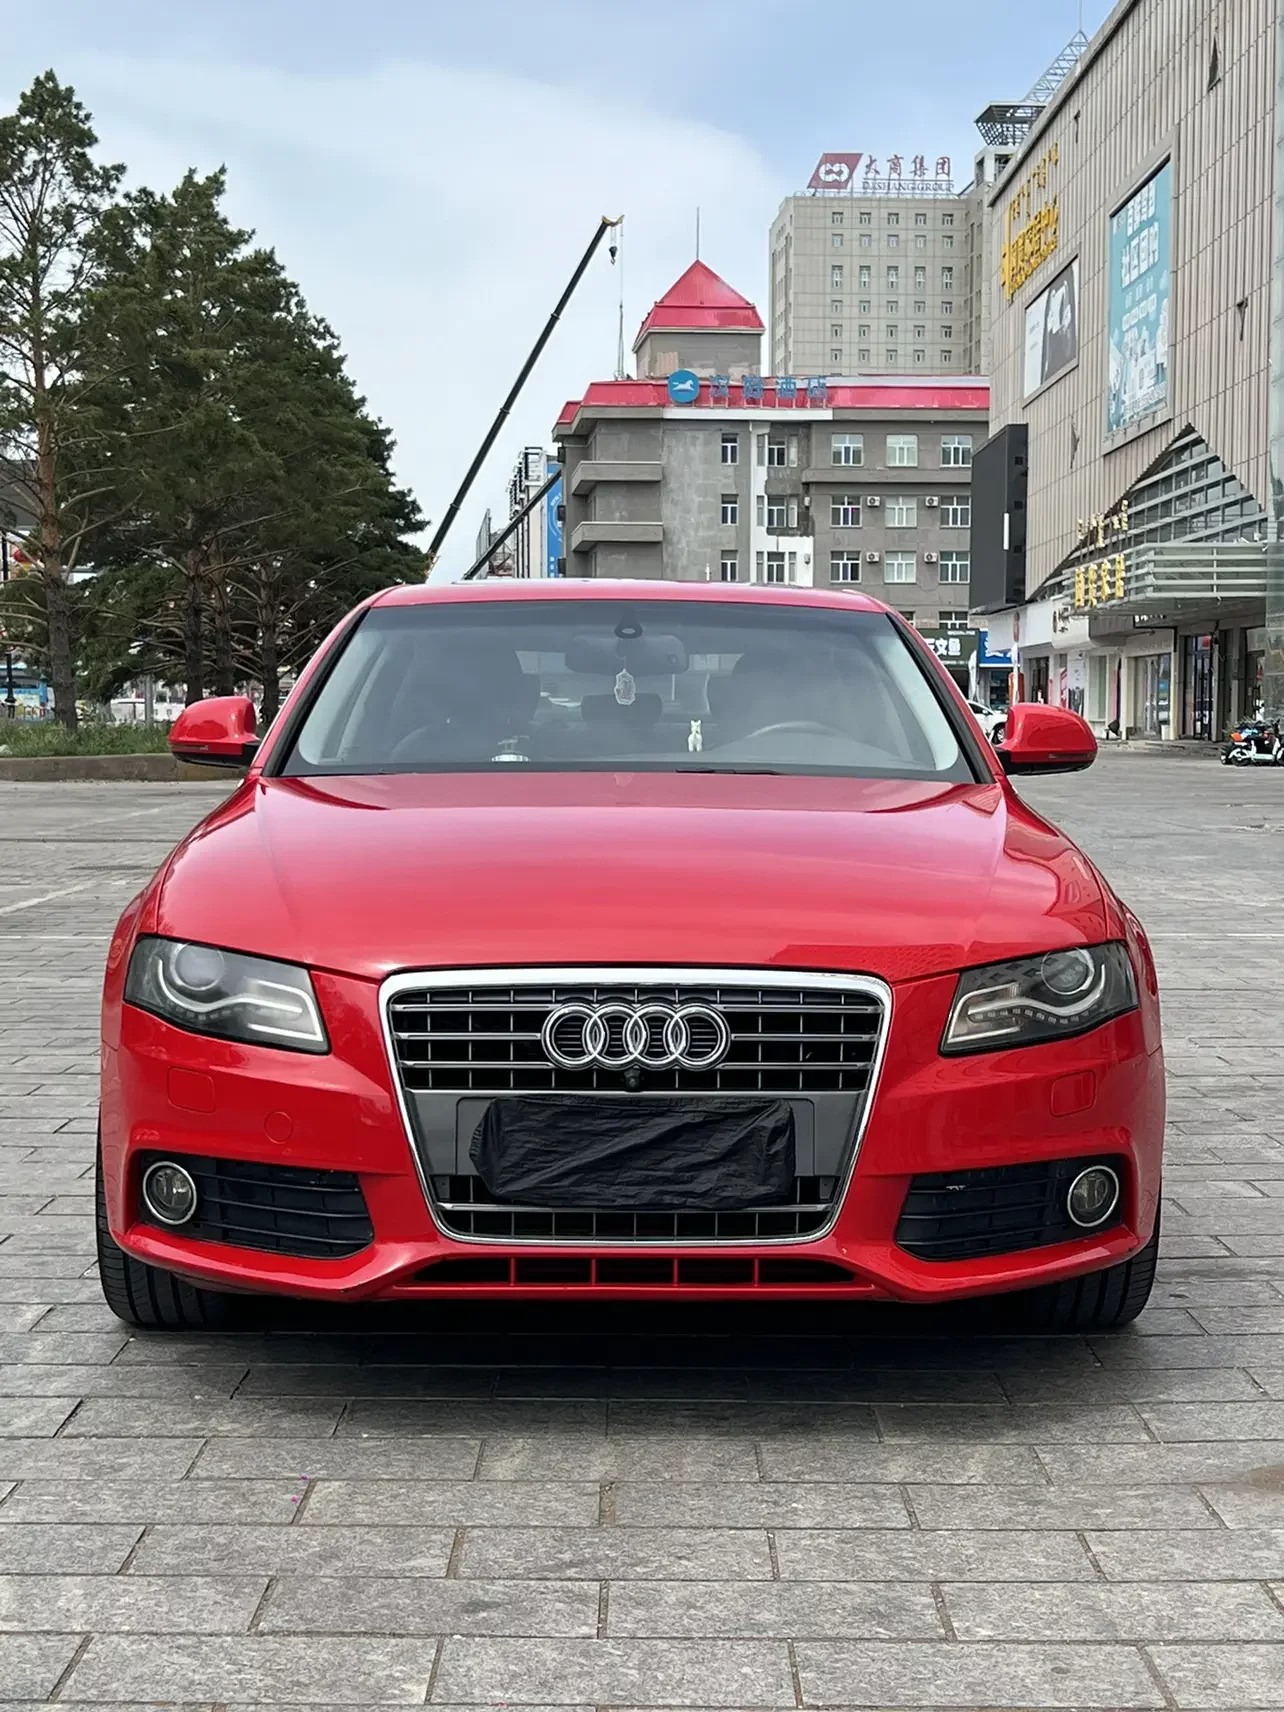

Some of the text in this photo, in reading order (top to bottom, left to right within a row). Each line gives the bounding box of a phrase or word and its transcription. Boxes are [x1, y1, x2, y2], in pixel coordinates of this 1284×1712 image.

[865, 154, 950, 177] 大商集团
[862, 181, 955, 192] DASHANG GROUP
